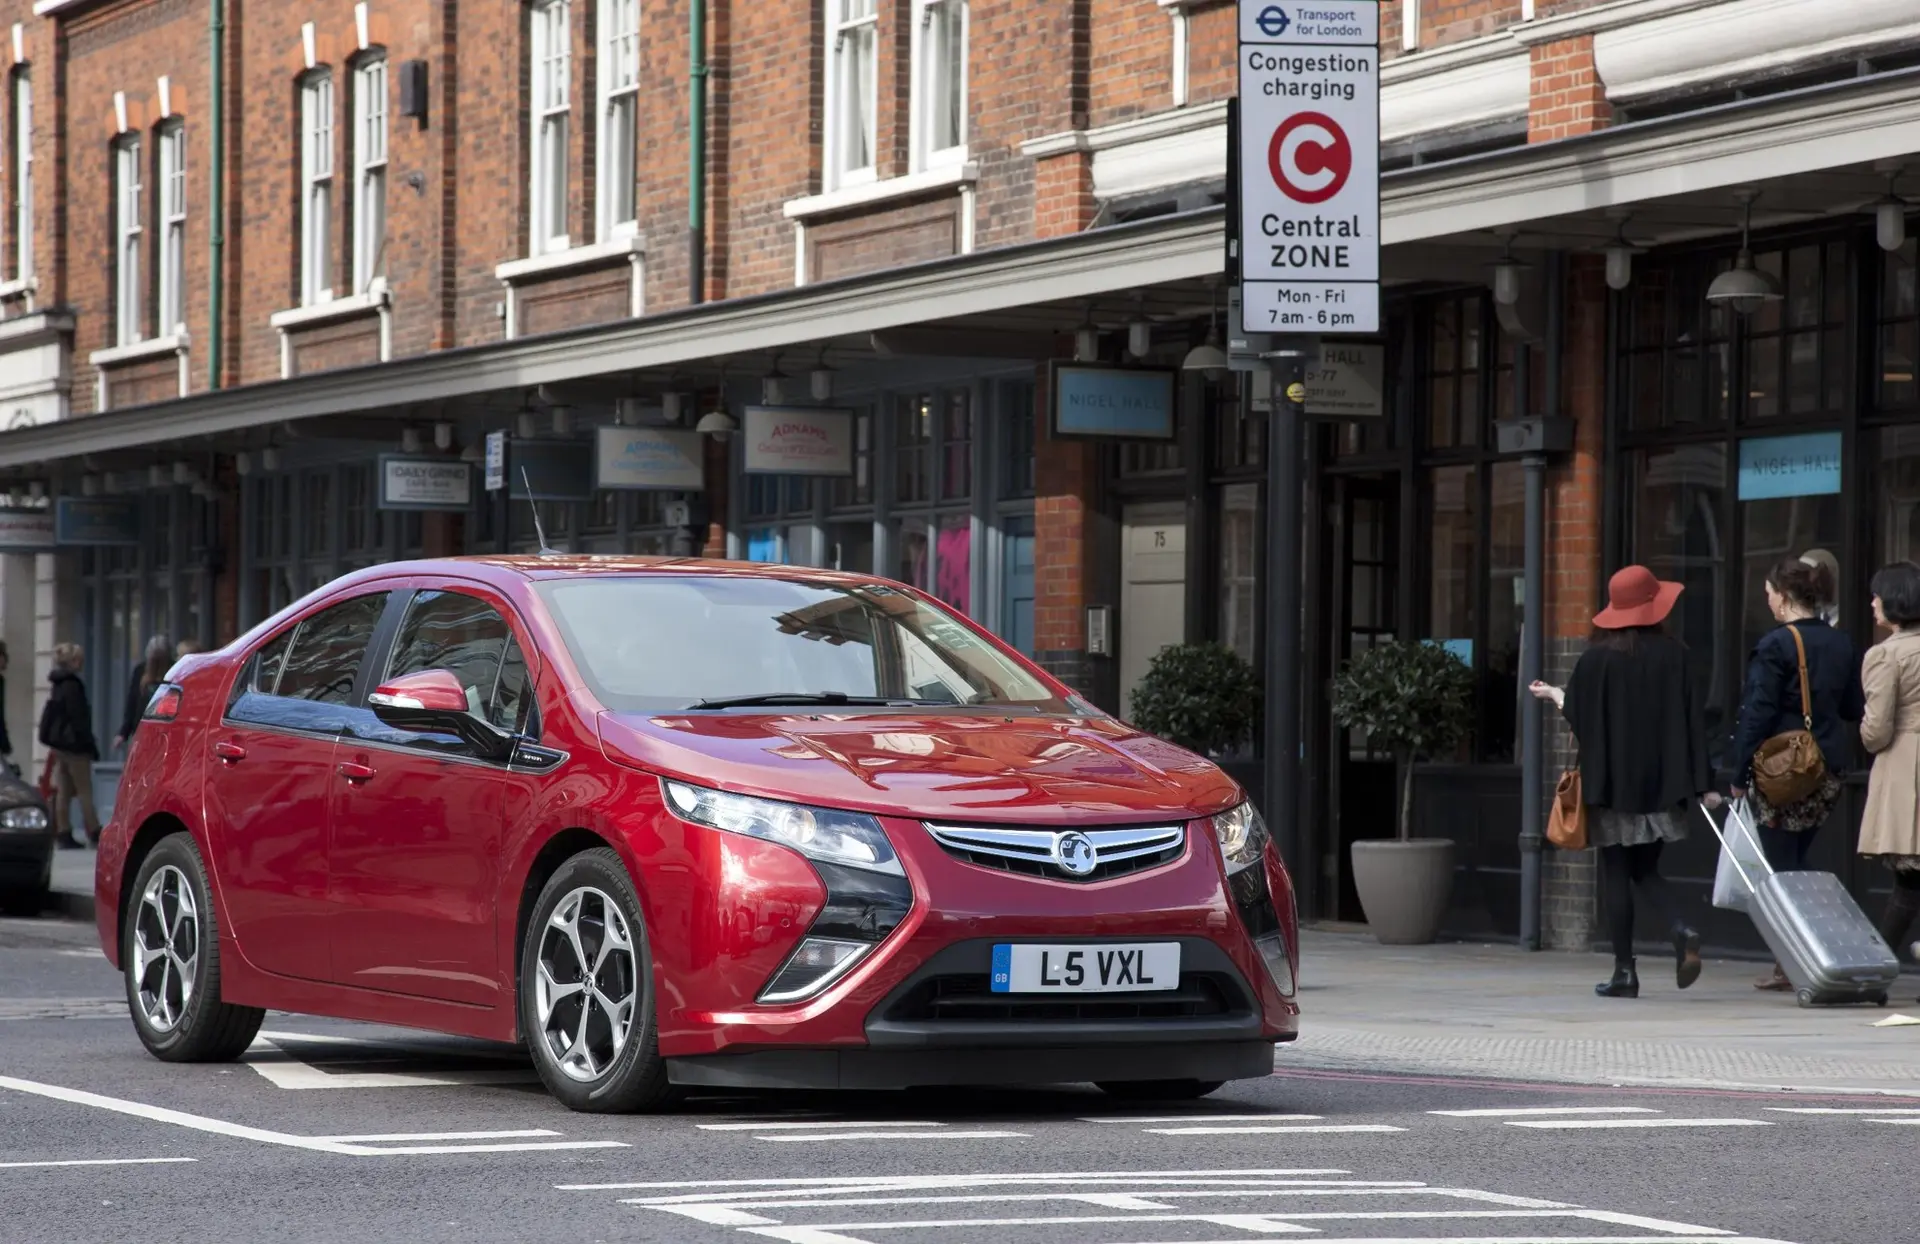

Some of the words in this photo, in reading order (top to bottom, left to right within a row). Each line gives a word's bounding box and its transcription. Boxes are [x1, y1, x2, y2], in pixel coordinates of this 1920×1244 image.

[1296, 8, 1356, 22] Transport
[1296, 24, 1313, 35] for
[1317, 25, 1362, 36] London
[1249, 52, 1369, 74] Congestion
[1263, 77, 1355, 100] charging
[1261, 213, 1360, 238] Central
[1271, 244, 1349, 268] ZONE
[1278, 289, 1311, 303] Mon
[1325, 289, 1345, 303] Fri
[1325, 350, 1365, 365] HALL
[1069, 393, 1116, 409] NIGEL
[1121, 394, 1160, 411] HALL
[771, 423, 828, 441] ADNAMS
[1753, 456, 1797, 476] NIGEL
[1803, 453, 1841, 472] HALL
[1154, 531, 1166, 548] 75
[1041, 951, 1085, 986] L5
[1097, 949, 1153, 986] VXL
[995, 974, 1008, 983] GB
